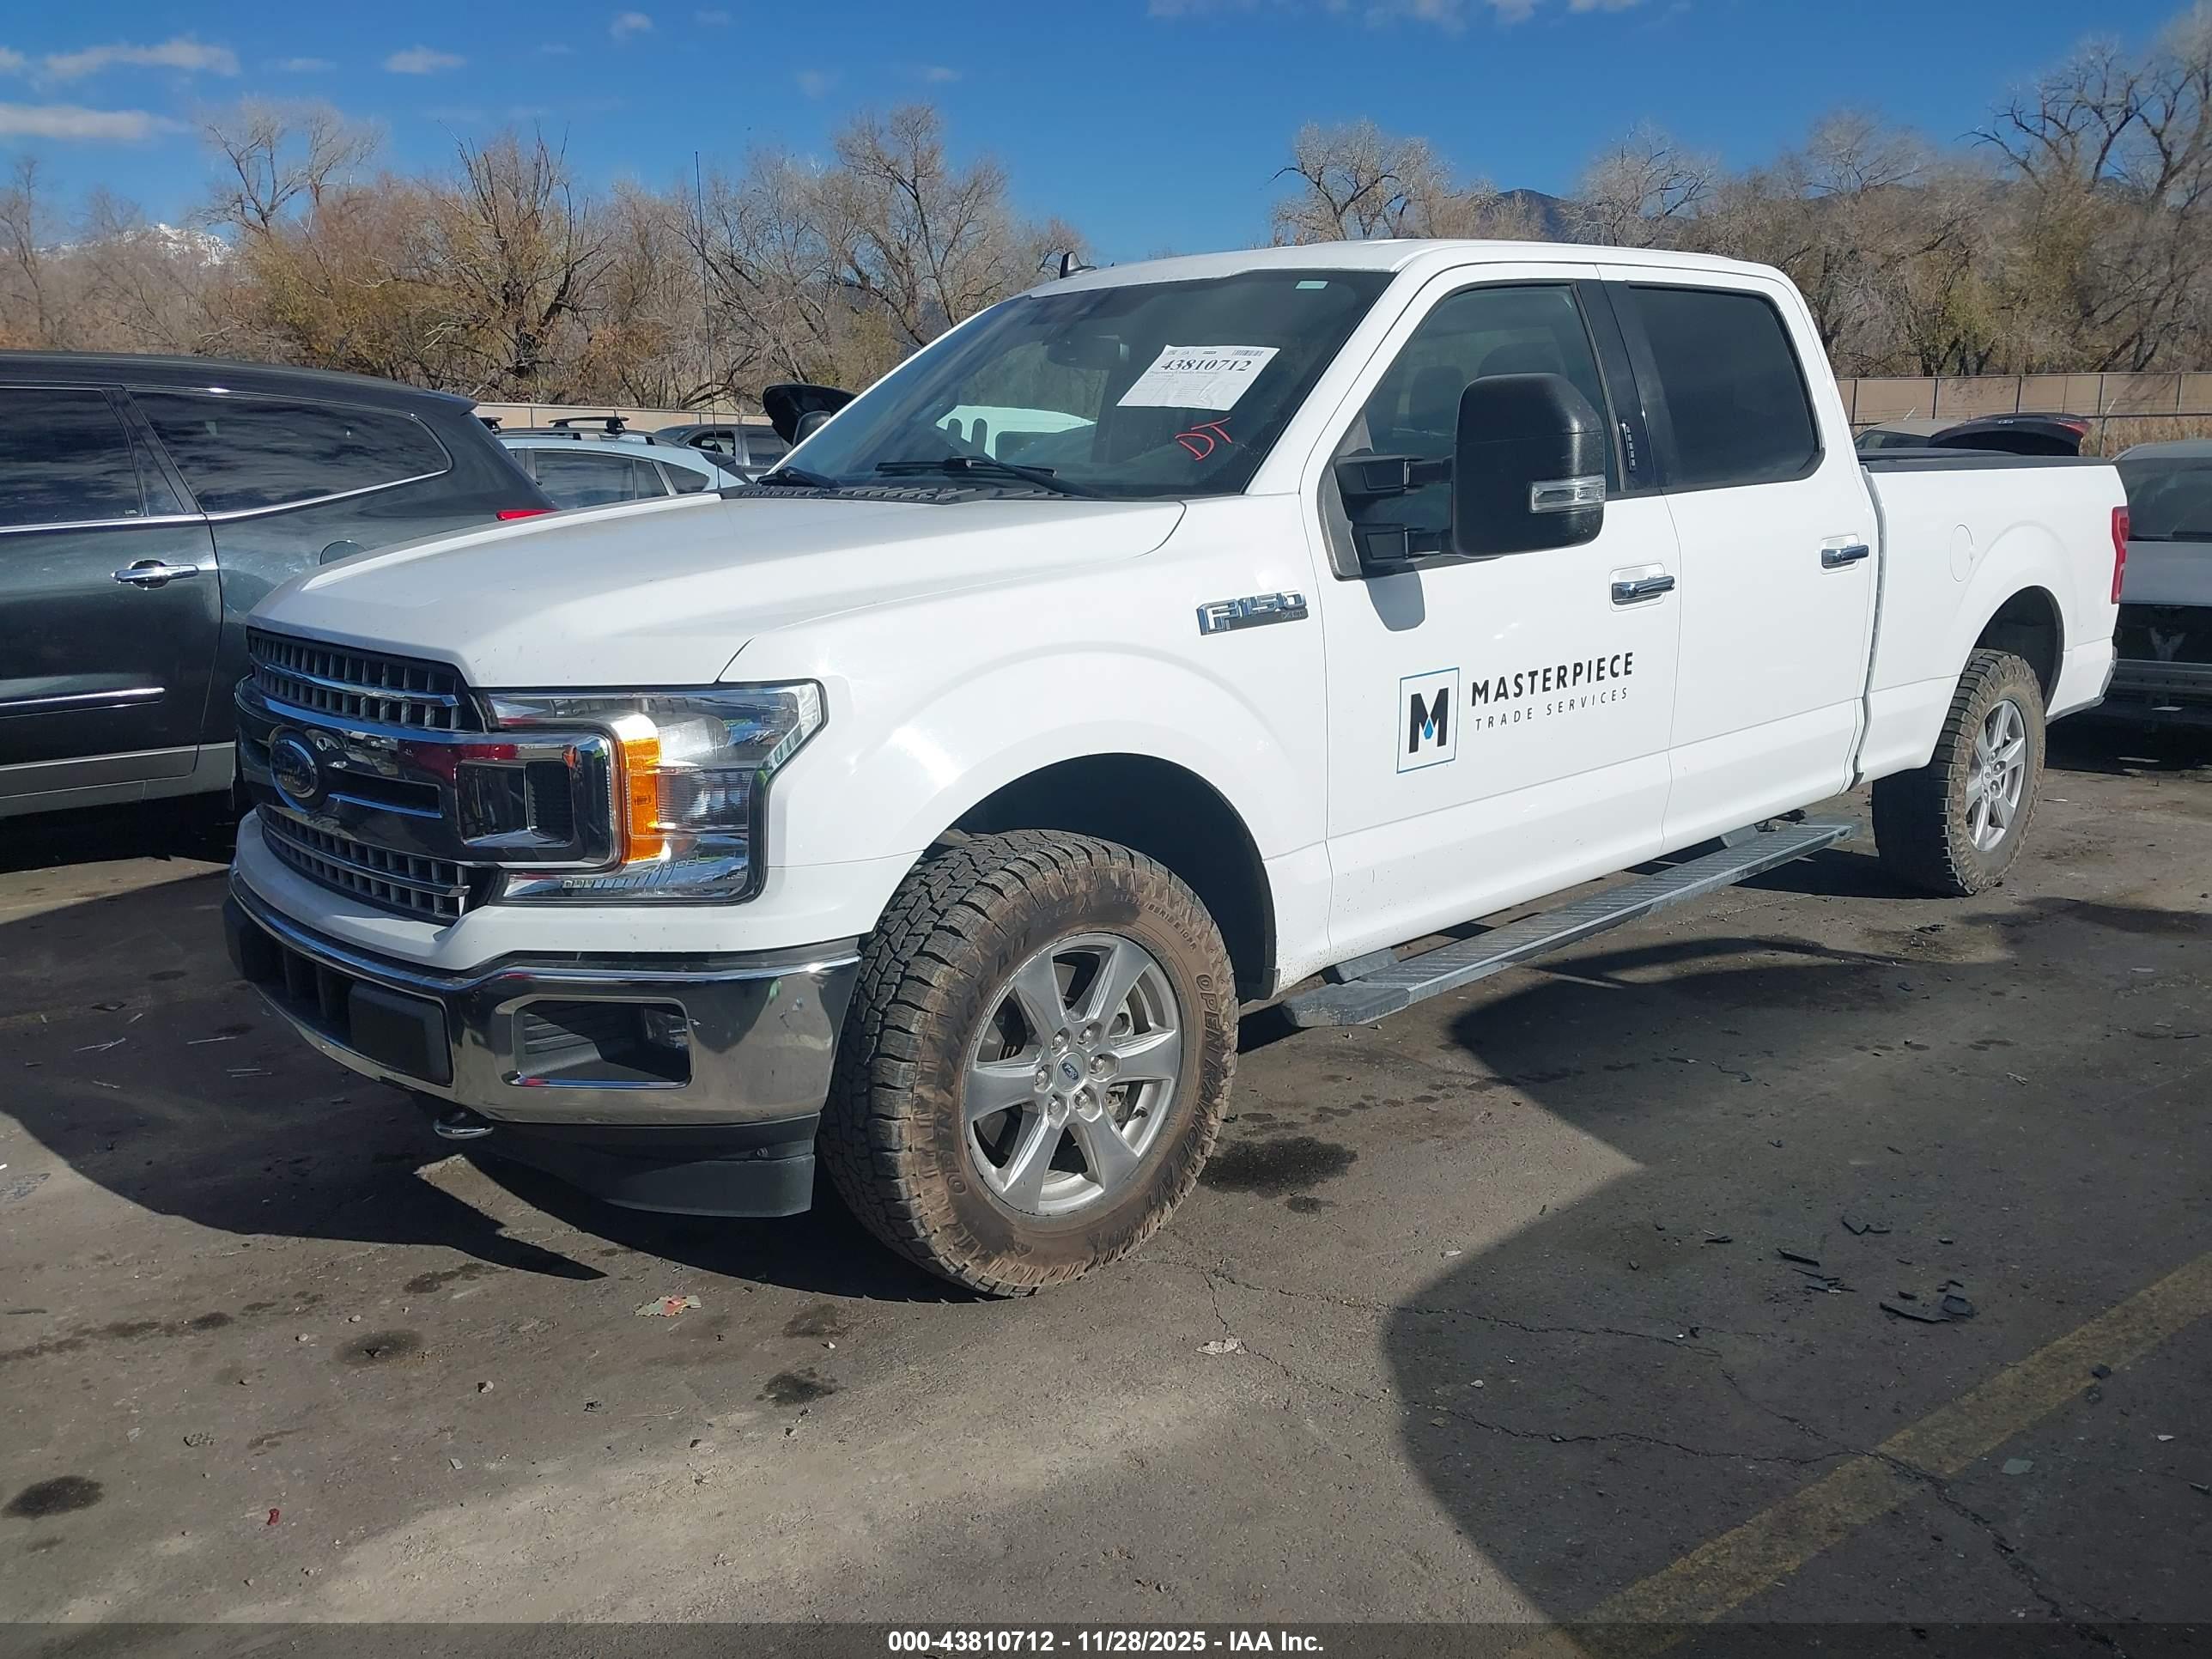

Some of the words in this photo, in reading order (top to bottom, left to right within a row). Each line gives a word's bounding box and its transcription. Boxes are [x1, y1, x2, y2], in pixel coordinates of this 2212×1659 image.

[1160, 359, 1253, 372] 43810712
[1175, 416, 1232, 461] DT
[1471, 652, 1633, 707] MASTERPIECE
[1475, 708, 1533, 732] TRADE
[1546, 687, 1628, 716] SERVICES
[1195, 973, 1219, 1052] OPEN
[1176, 1056, 1219, 1170] RANGE
